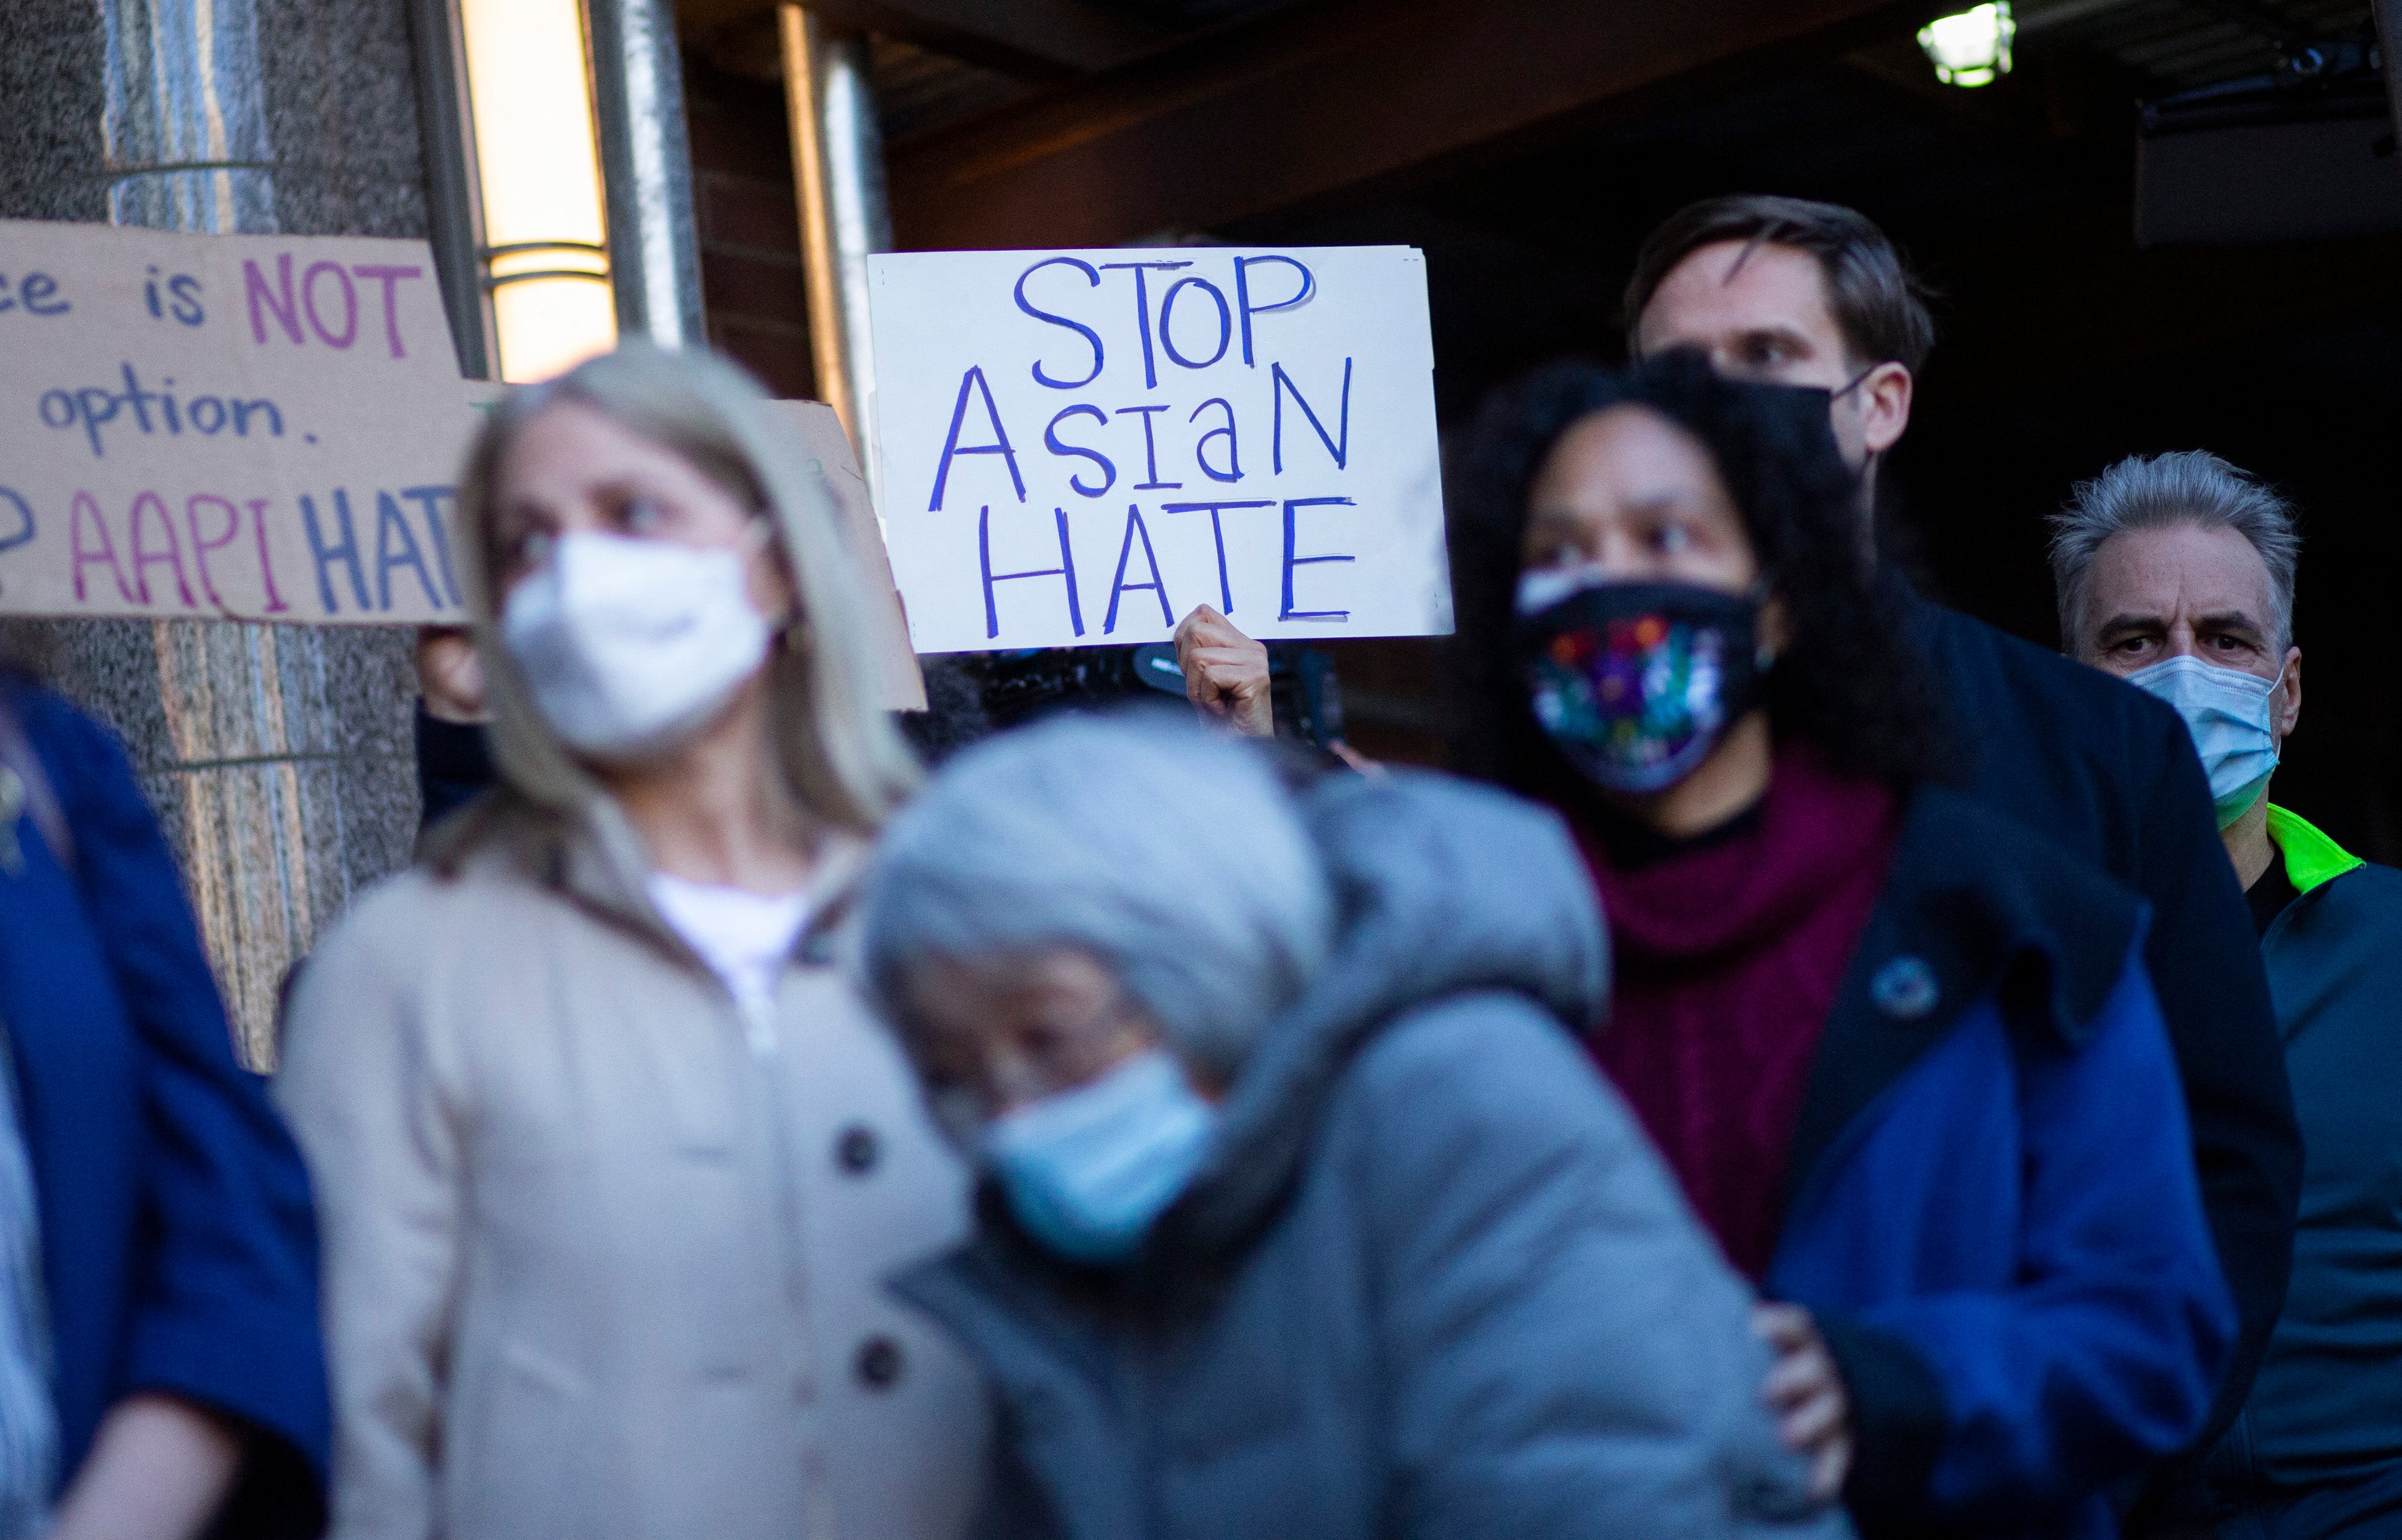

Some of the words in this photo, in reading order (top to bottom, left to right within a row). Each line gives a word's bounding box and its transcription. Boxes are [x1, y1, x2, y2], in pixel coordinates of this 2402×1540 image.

[143, 264, 205, 327] is
[242, 253, 422, 359] NOT
[38, 361, 318, 458] option.
[70, 489, 289, 619] AAPI
[297, 484, 466, 615] HAT
[978, 496, 1357, 639] HATE
